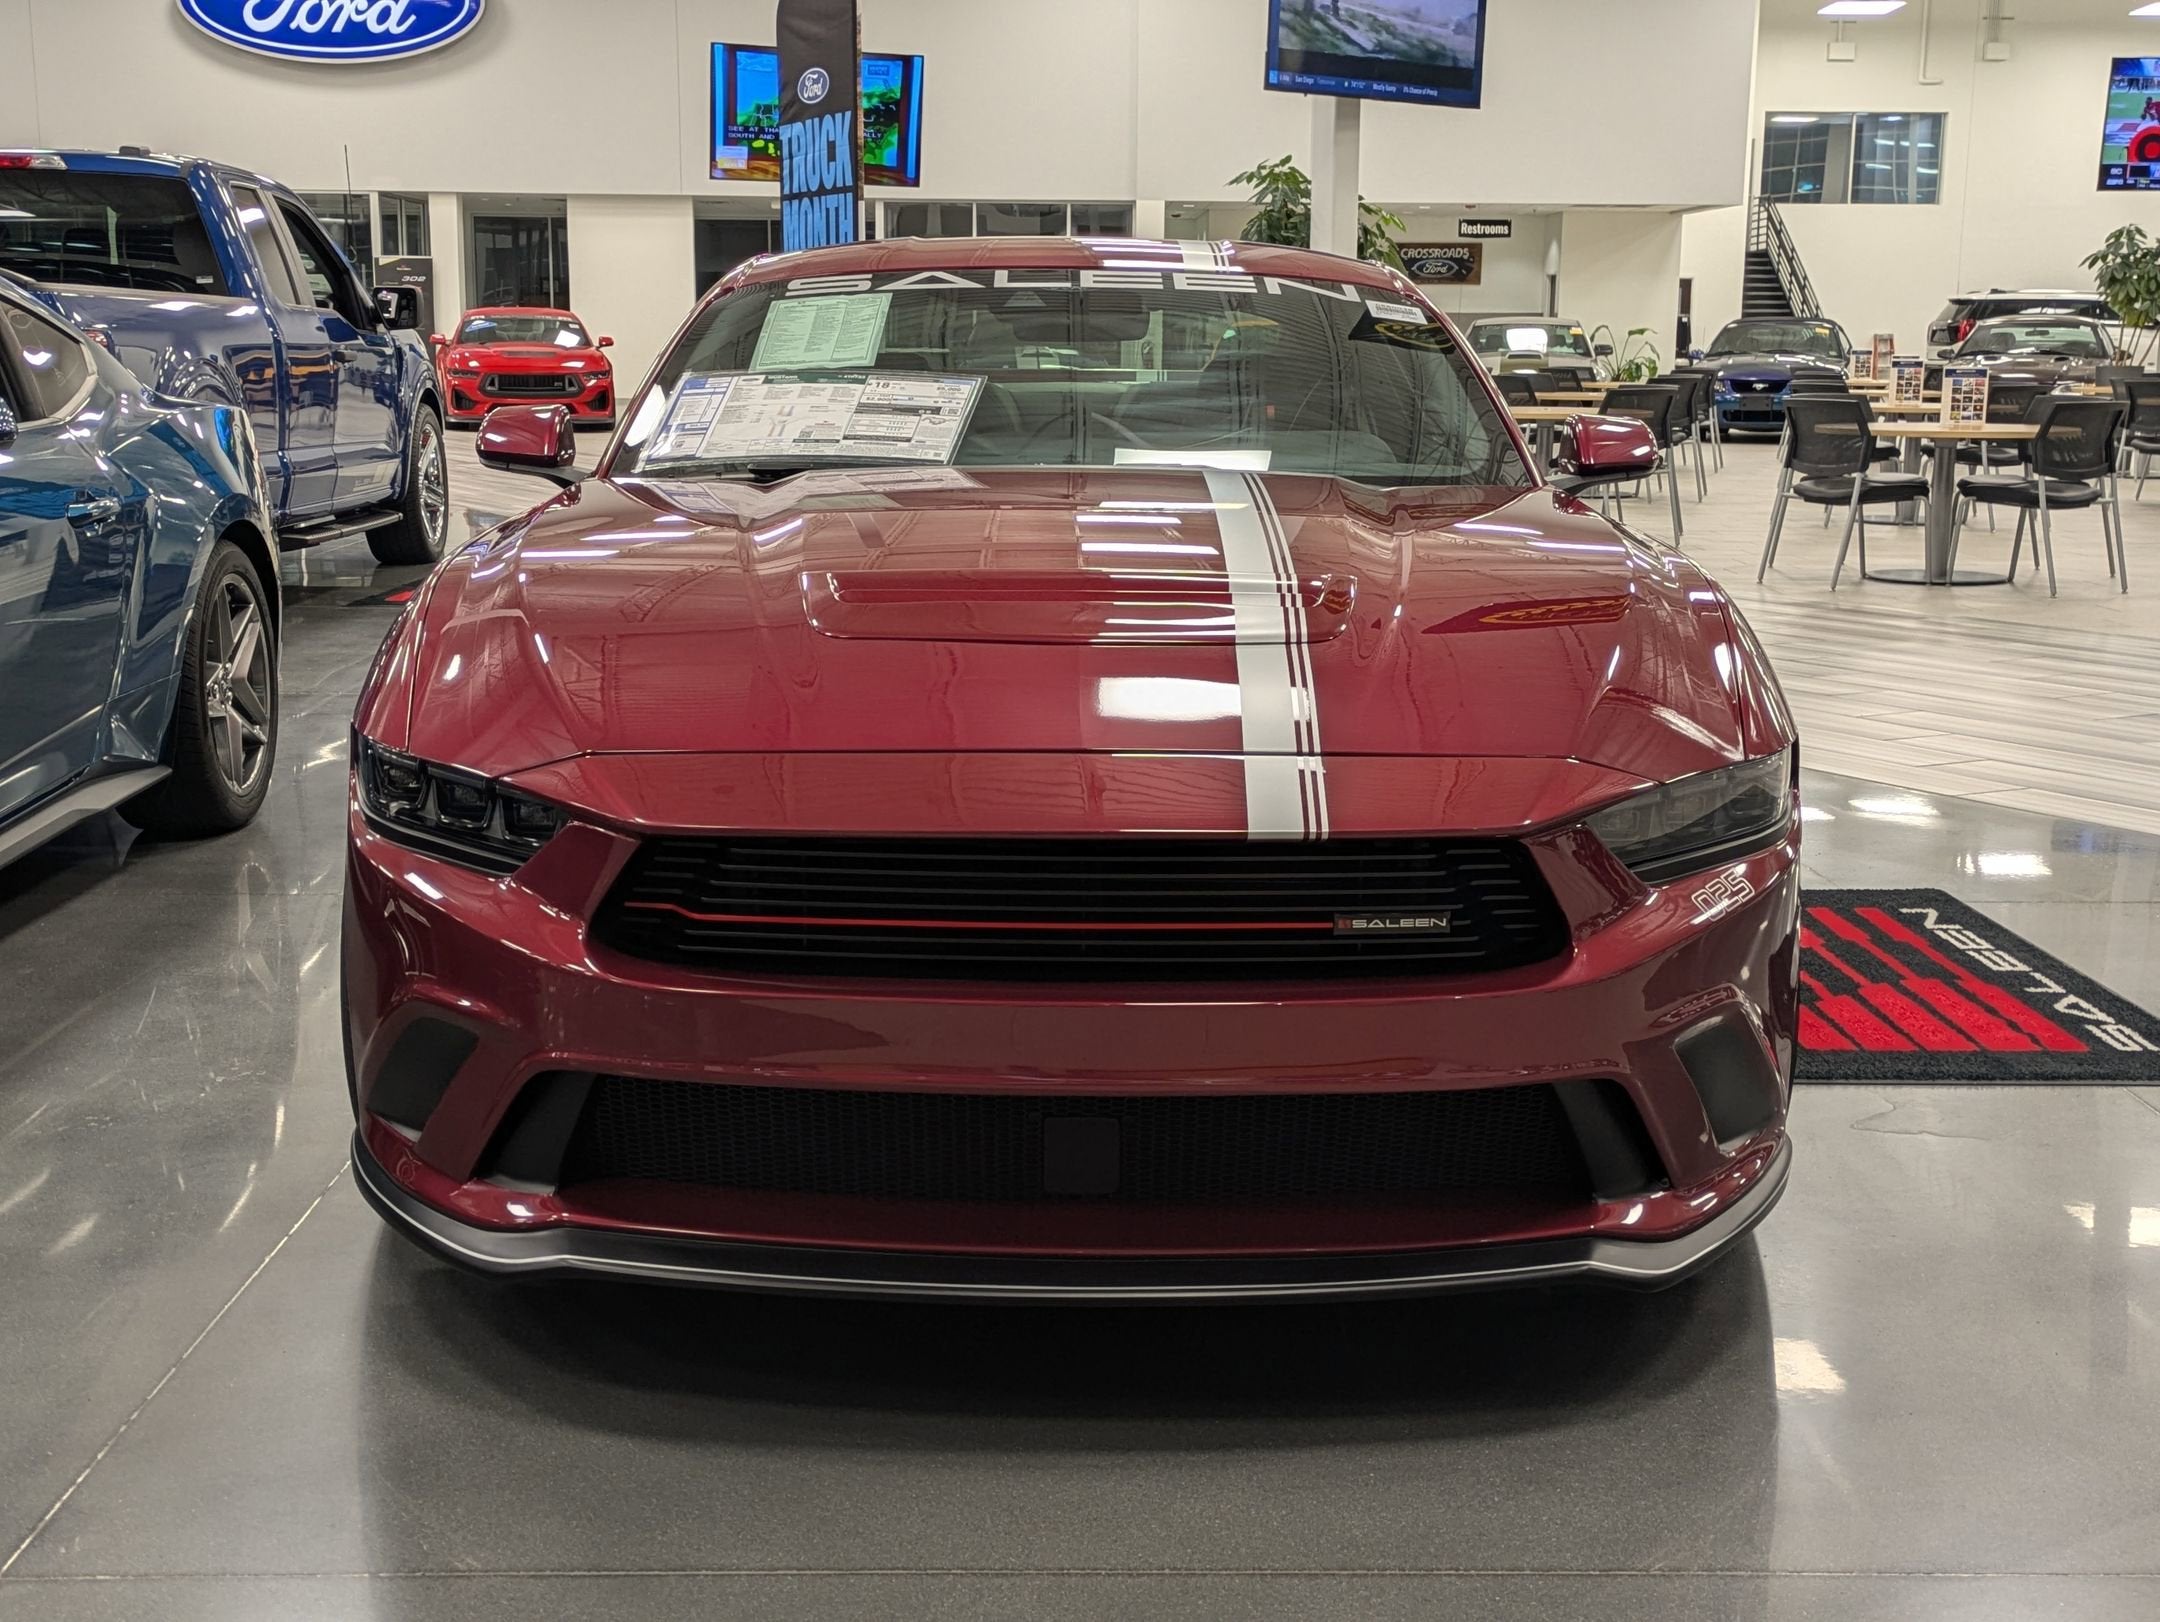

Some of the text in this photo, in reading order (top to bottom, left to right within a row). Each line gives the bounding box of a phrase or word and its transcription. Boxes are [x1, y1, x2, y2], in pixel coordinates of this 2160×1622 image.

[803, 73, 824, 99] Ford
[779, 110, 853, 194] TRUCK
[783, 192, 853, 250] MONTH
[1461, 222, 1509, 235] Restrooms
[1401, 248, 1469, 260] CROSSROADS
[1423, 261, 1448, 274] Ford
[785, 270, 1362, 303] SALEEN
[1691, 865, 1755, 922] 025
[1352, 918, 1447, 929] SALEEN
[1899, 906, 2160, 1052] SALEEN
